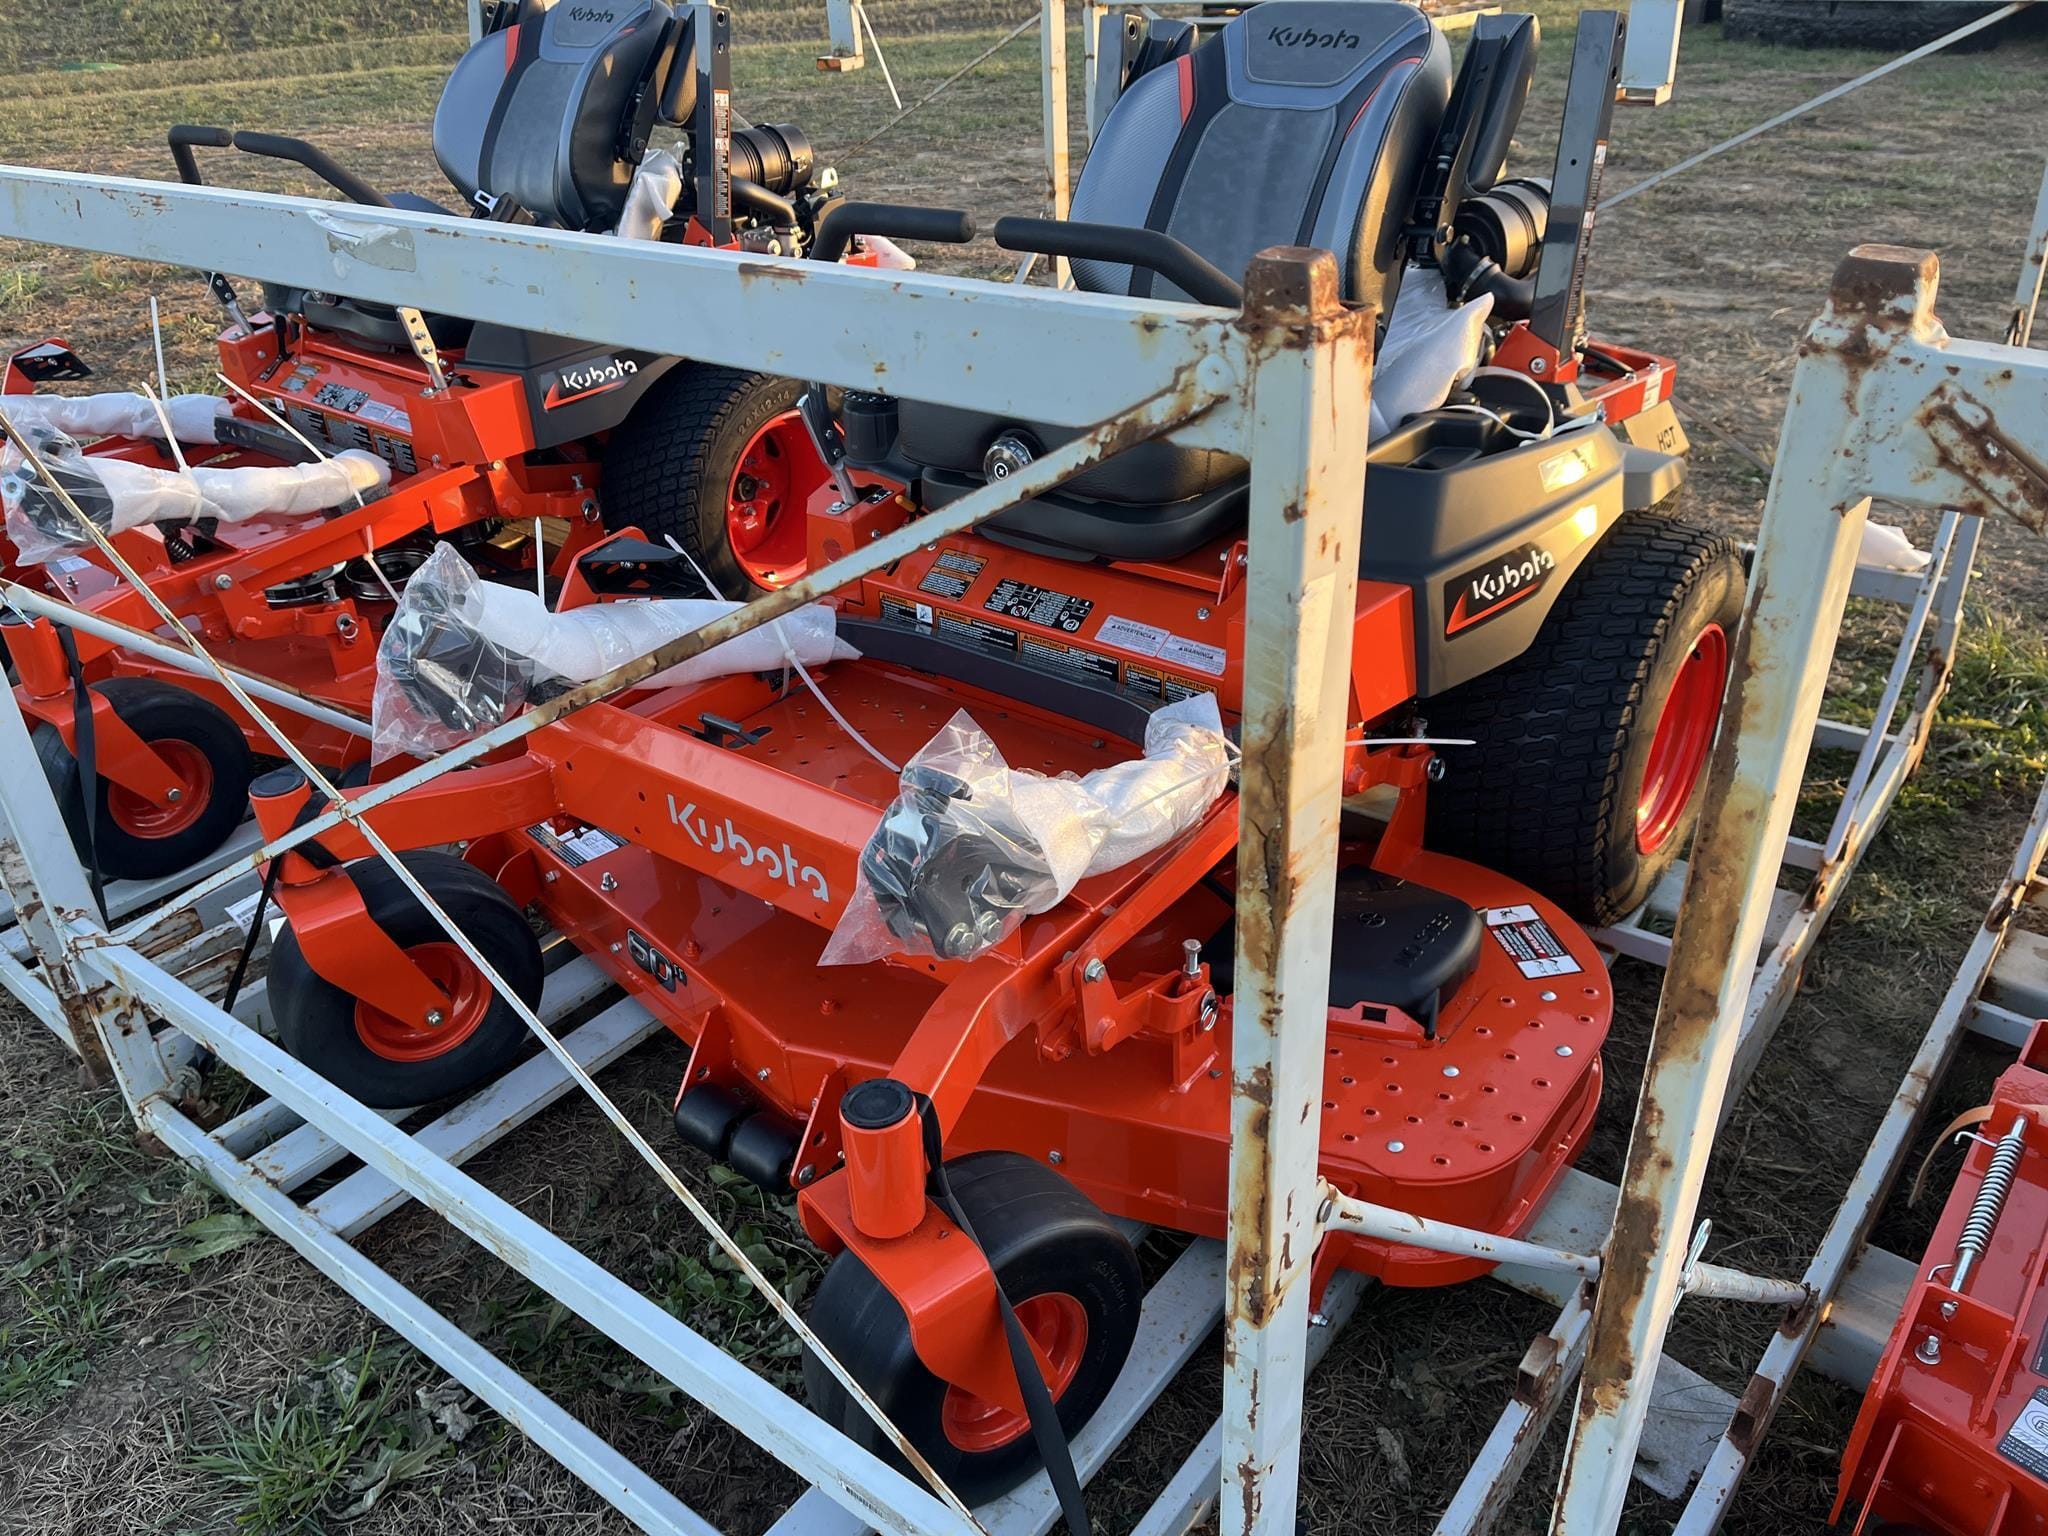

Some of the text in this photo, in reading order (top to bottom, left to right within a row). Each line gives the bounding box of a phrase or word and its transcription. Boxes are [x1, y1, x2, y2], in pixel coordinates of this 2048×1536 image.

[569, 7, 614, 23] Kubota
[1268, 27, 1360, 49] Kubota
[562, 359, 638, 390] Kubota
[1657, 425, 1677, 452] HOT
[1472, 550, 1555, 600] Kubota
[1116, 625, 1152, 639] ADVERTENCIA
[1029, 637, 1066, 650] ADVERTENCIA
[1183, 646, 1211, 660] WARNING
[667, 794, 829, 903] Kubota
